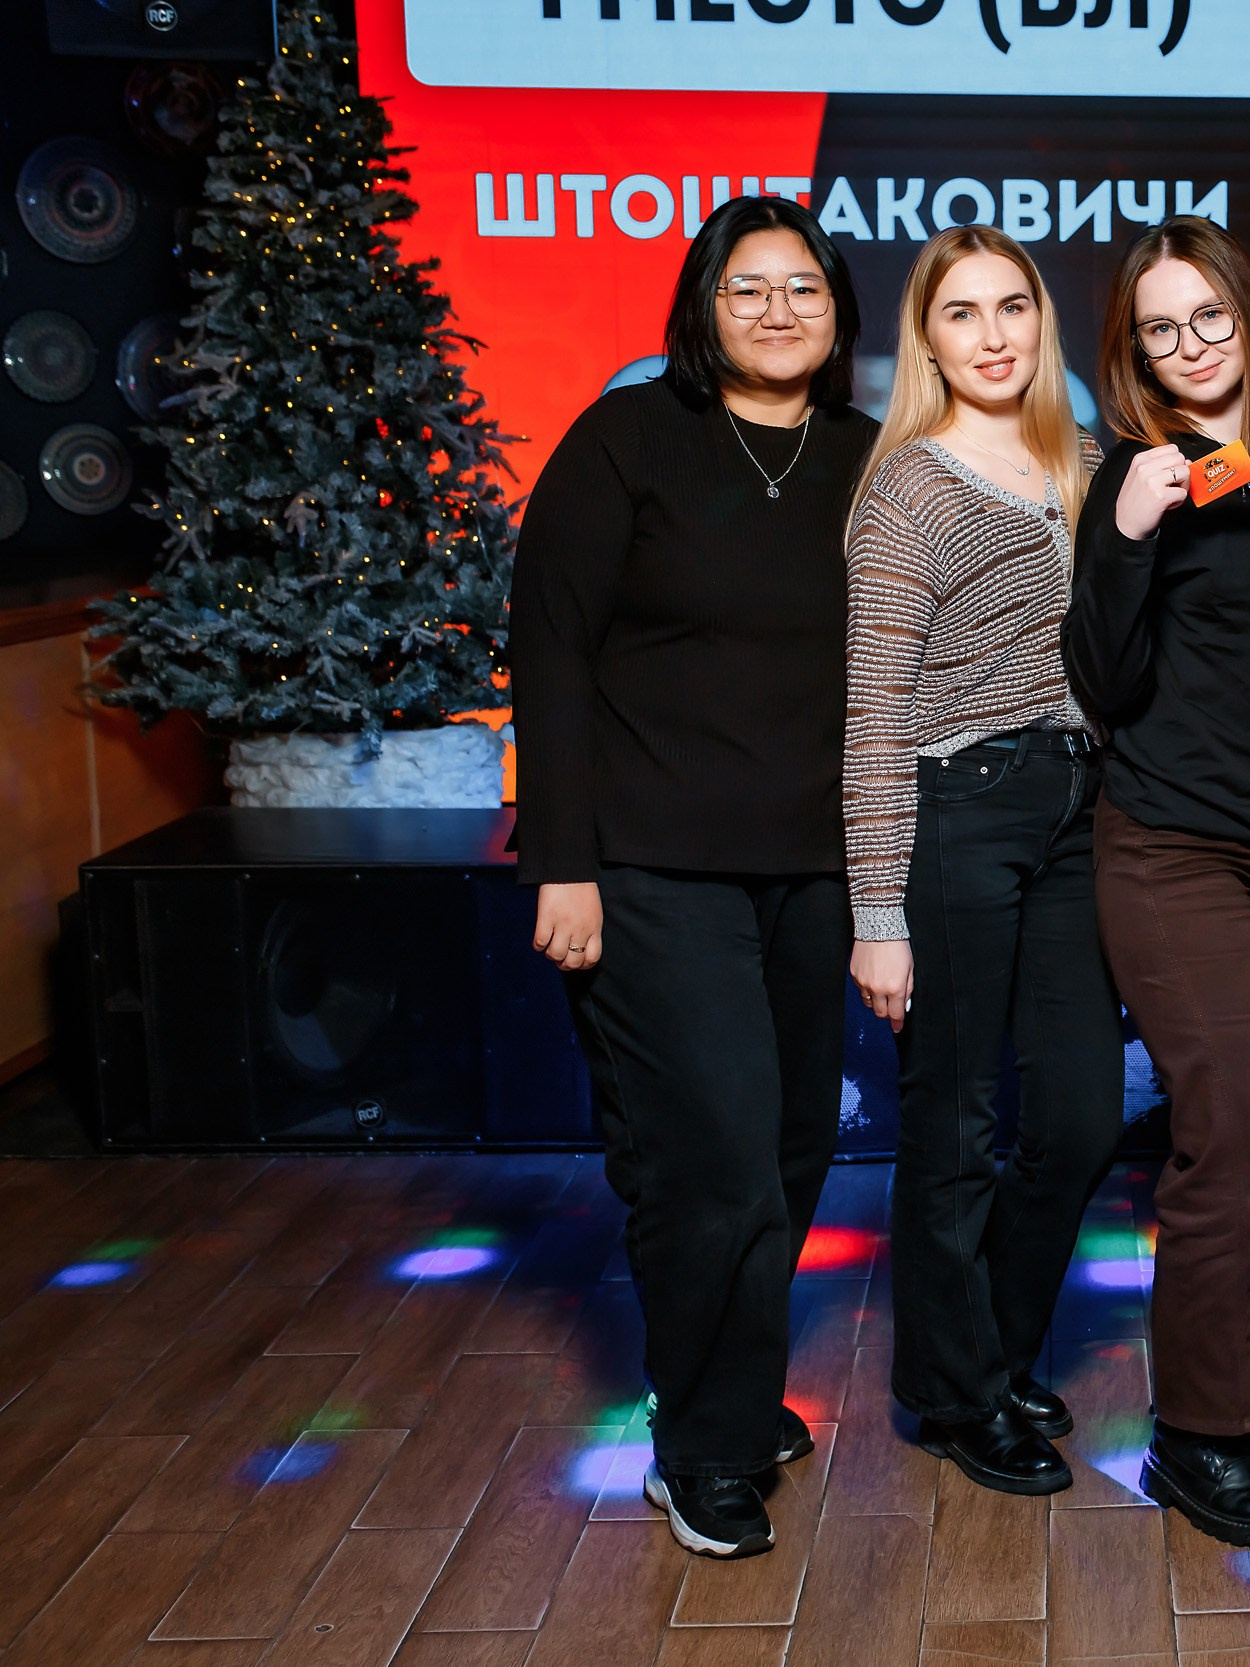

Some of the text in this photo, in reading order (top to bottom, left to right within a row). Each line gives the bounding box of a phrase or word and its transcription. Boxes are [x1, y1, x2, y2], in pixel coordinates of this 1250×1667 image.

[149, 9, 174, 22] RCF
[1207, 464, 1225, 477] QUIZ
[358, 1106, 379, 1121] RCF
